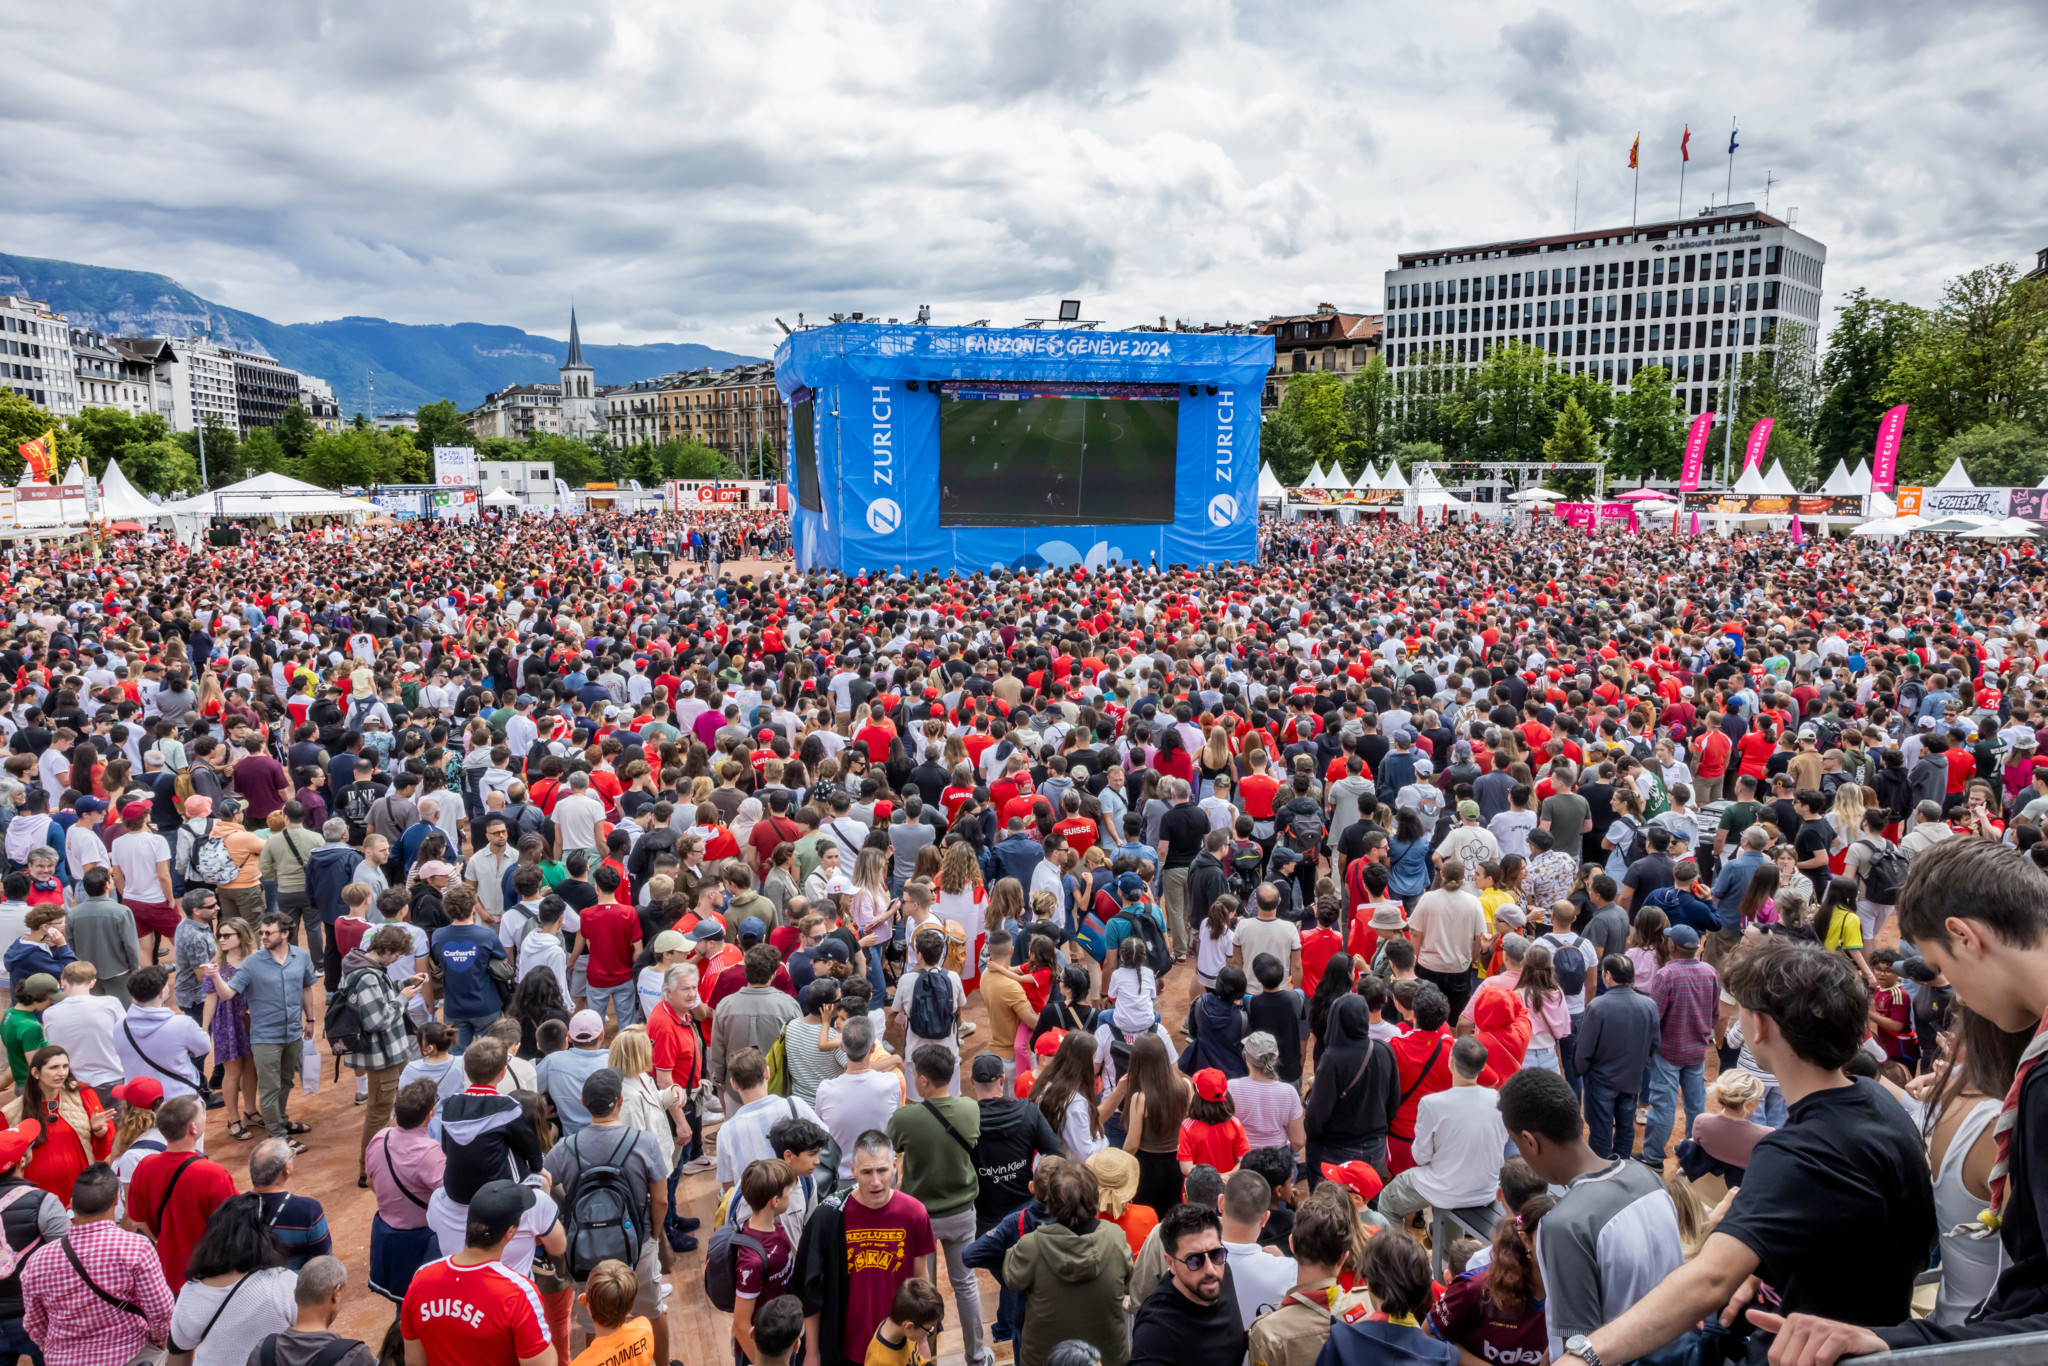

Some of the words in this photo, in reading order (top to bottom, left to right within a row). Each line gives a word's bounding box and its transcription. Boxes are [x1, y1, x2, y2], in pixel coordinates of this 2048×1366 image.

[1678, 240, 1712, 249] GROUPE
[1714, 234, 1760, 246] SECURITAS
[965, 335, 1047, 353] FANZONE
[1066, 334, 1129, 356] GENÈVE
[1131, 340, 1171, 357] 2024
[815, 387, 823, 484] URICH
[872, 385, 893, 486] ZURICH
[1216, 390, 1234, 483] ZURICH
[1688, 439, 1702, 478] MATEUS
[1750, 441, 1761, 460] EUS
[1880, 434, 1894, 478] MATEUS
[1575, 507, 1619, 515] MAUS
[753, 757, 777, 767] SUIS
[1063, 825, 1091, 835] SUISSE
[1008, 1159, 1027, 1172] Klein
[846, 1231, 904, 1241] RECLUSES
[856, 1252, 889, 1268] SKA
[419, 1297, 485, 1329] SUISSE
[598, 1337, 648, 1366] OMMER
[1484, 1340, 1543, 1365] balex
